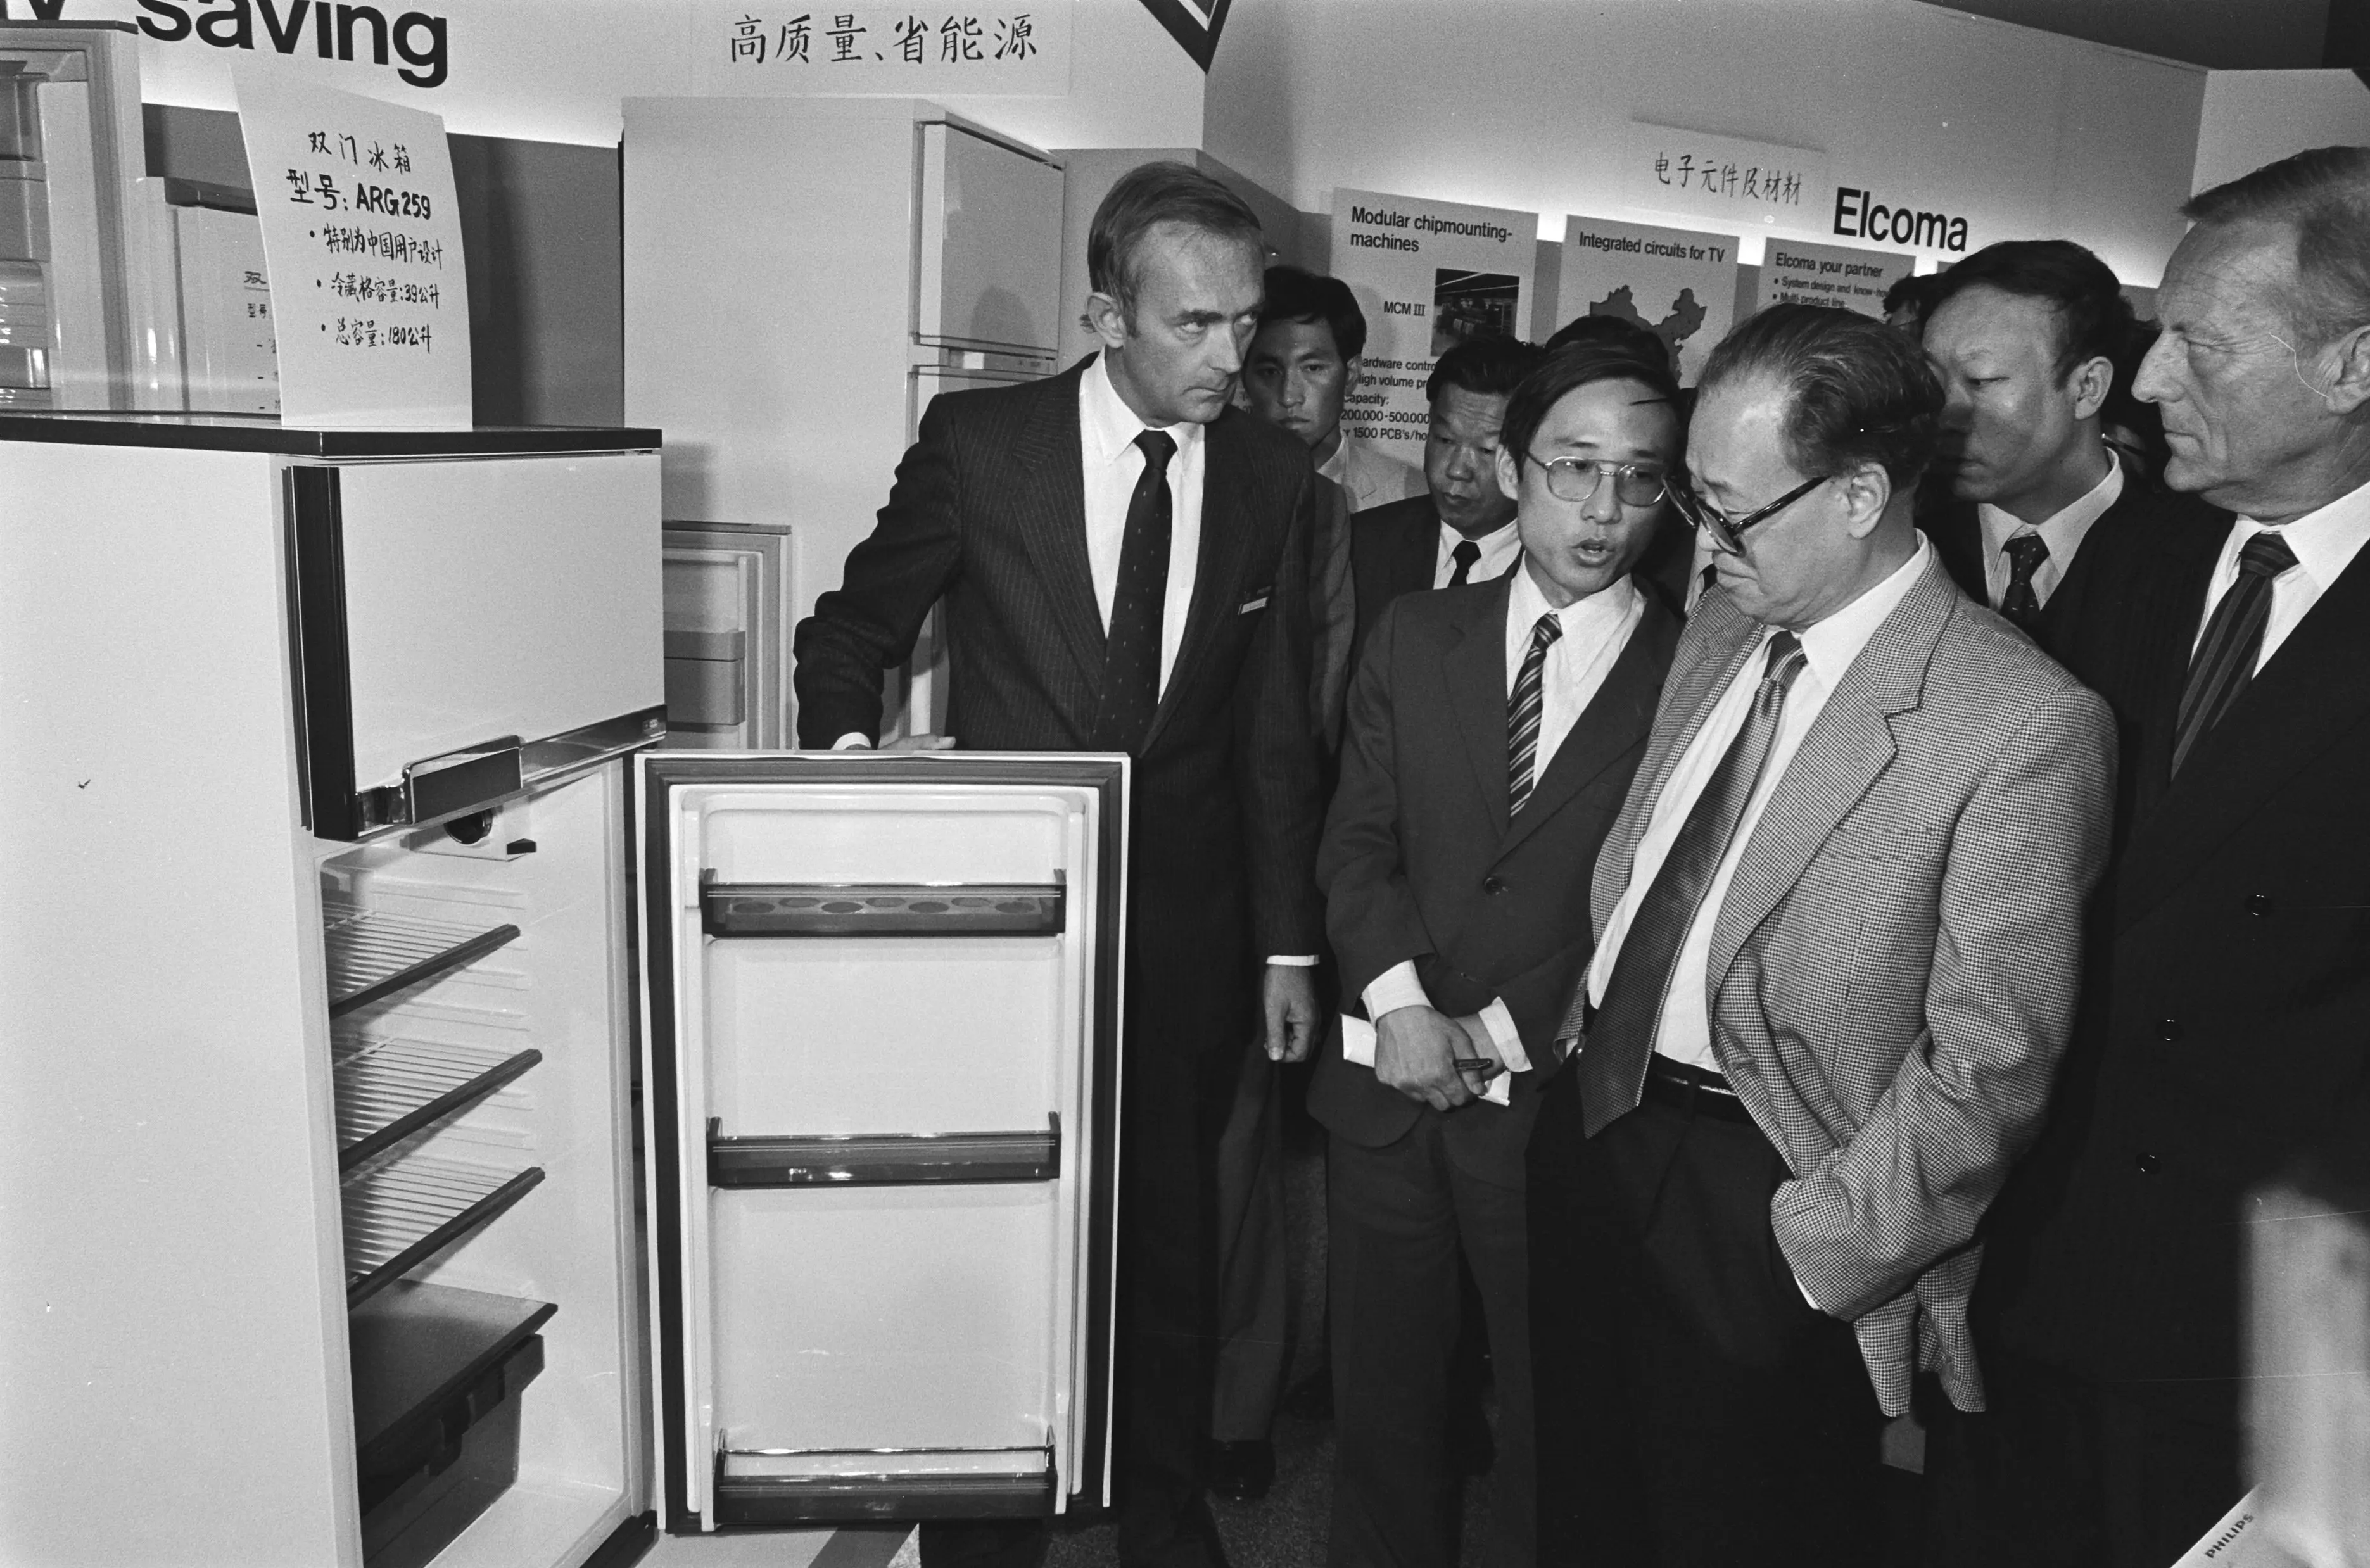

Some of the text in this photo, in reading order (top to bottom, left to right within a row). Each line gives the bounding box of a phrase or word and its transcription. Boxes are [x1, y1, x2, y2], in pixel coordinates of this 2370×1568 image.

[136, 0, 448, 89] saving
[730, 14, 1037, 65] 高质量、省能源
[308, 130, 411, 175] 双门冰箱
[355, 182, 431, 220] ARG259
[1352, 206, 1513, 243] Modular chipmounting-
[1834, 187, 1968, 252] Elcoma
[324, 222, 443, 270] 特别为中国用户设计
[1350, 232, 1419, 253] machines
[1580, 232, 1725, 263] Integrated circuits for TV
[1776, 252, 1884, 277] Elcoma your partner
[1782, 275, 1809, 289] System
[1811, 279, 1835, 293] design
[1383, 301, 1426, 317] MCM III
[1362, 357, 1436, 372] ardware contro
[1379, 375, 1414, 388] volume
[1416, 380, 1427, 390] pr
[1353, 426, 1378, 439] 1500
[1380, 427, 1428, 441] PCB's/ho
[2205, 1514, 2254, 1559] PHILIPS
